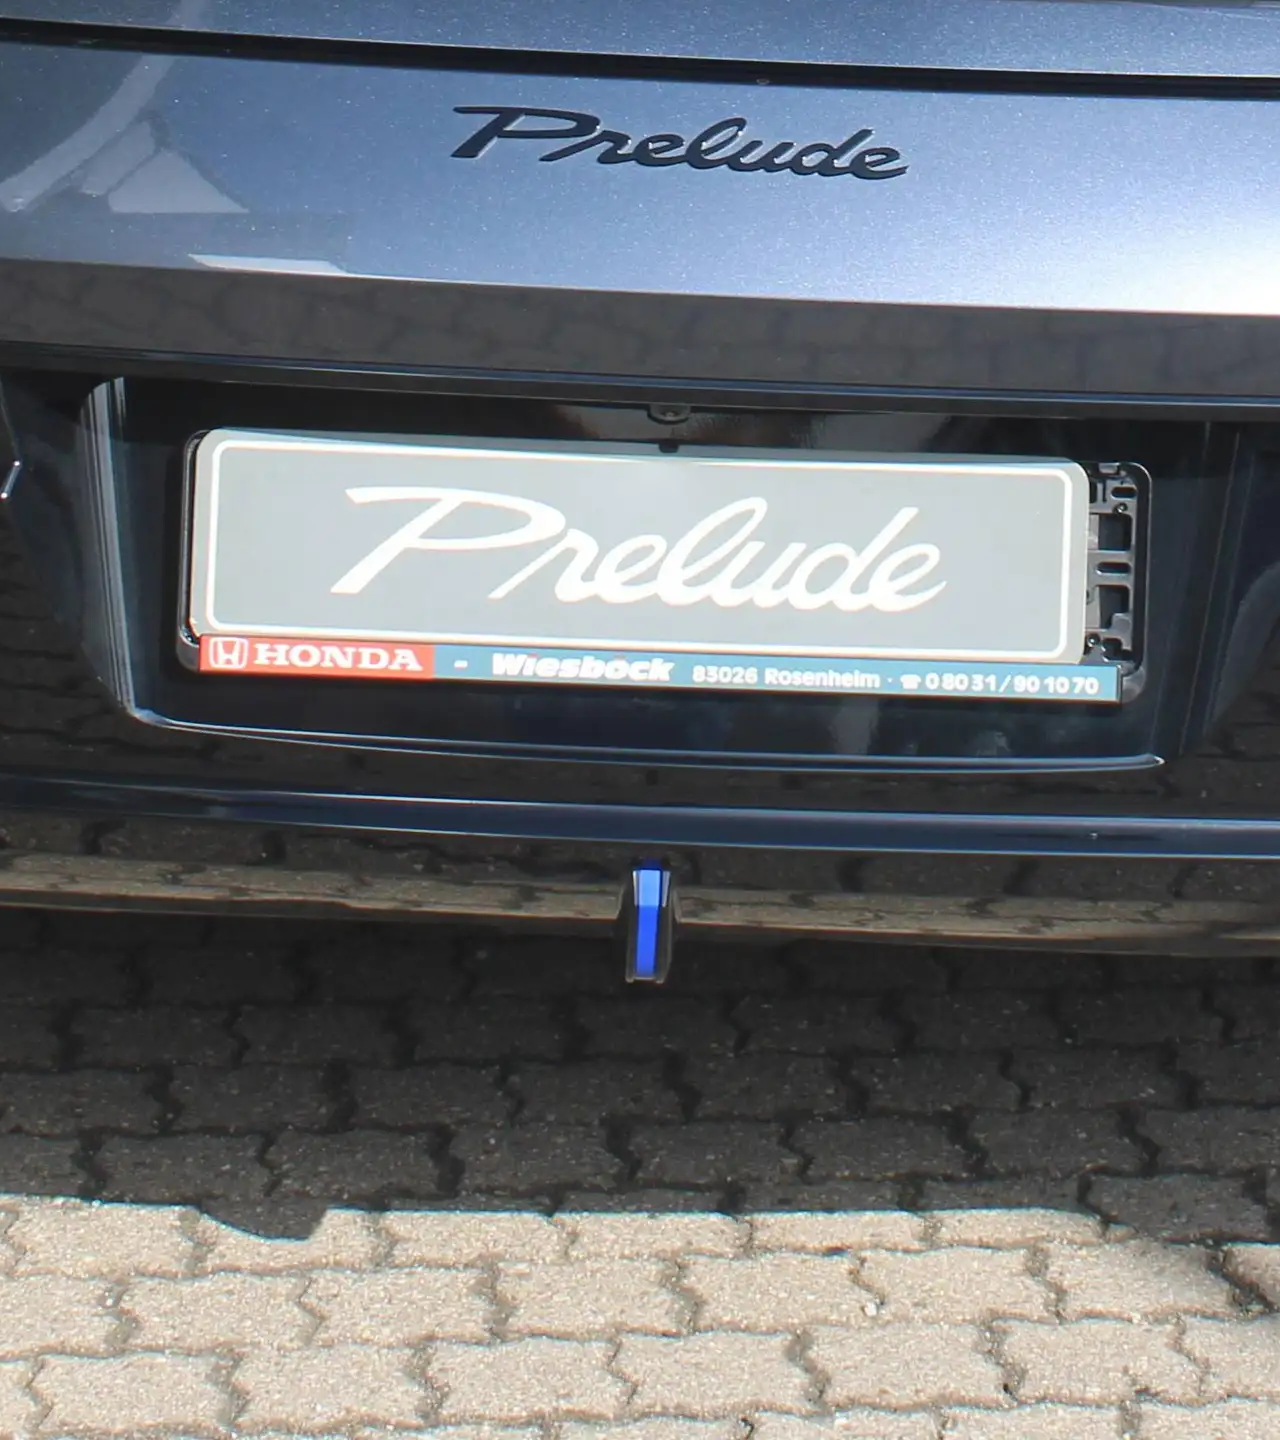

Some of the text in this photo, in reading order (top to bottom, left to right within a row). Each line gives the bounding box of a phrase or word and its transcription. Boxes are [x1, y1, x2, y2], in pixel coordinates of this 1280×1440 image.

[450, 105, 909, 180] Prelude
[329, 486, 948, 613] Prelude
[253, 643, 424, 673] HONDA
[692, 665, 758, 684] 83026
[764, 667, 881, 689] Rosenheim
